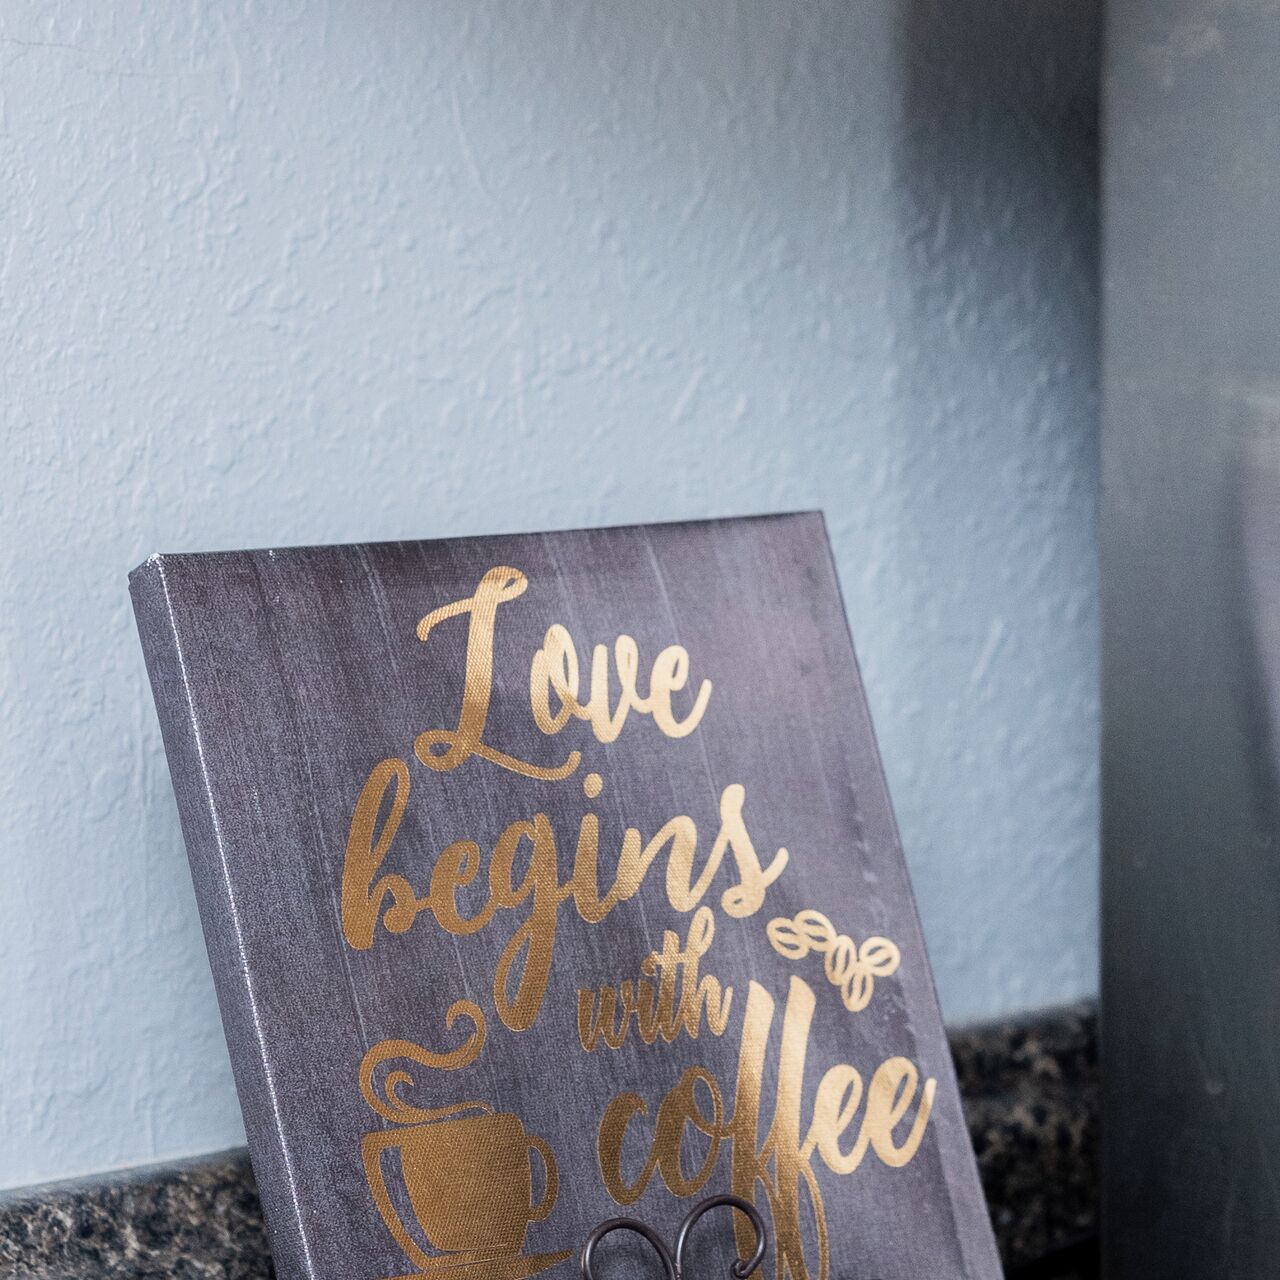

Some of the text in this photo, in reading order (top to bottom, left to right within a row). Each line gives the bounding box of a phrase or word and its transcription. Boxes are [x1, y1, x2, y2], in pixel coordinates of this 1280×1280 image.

[415, 566, 713, 781] Love
[341, 758, 790, 1032] begins
[578, 906, 735, 1054] with
